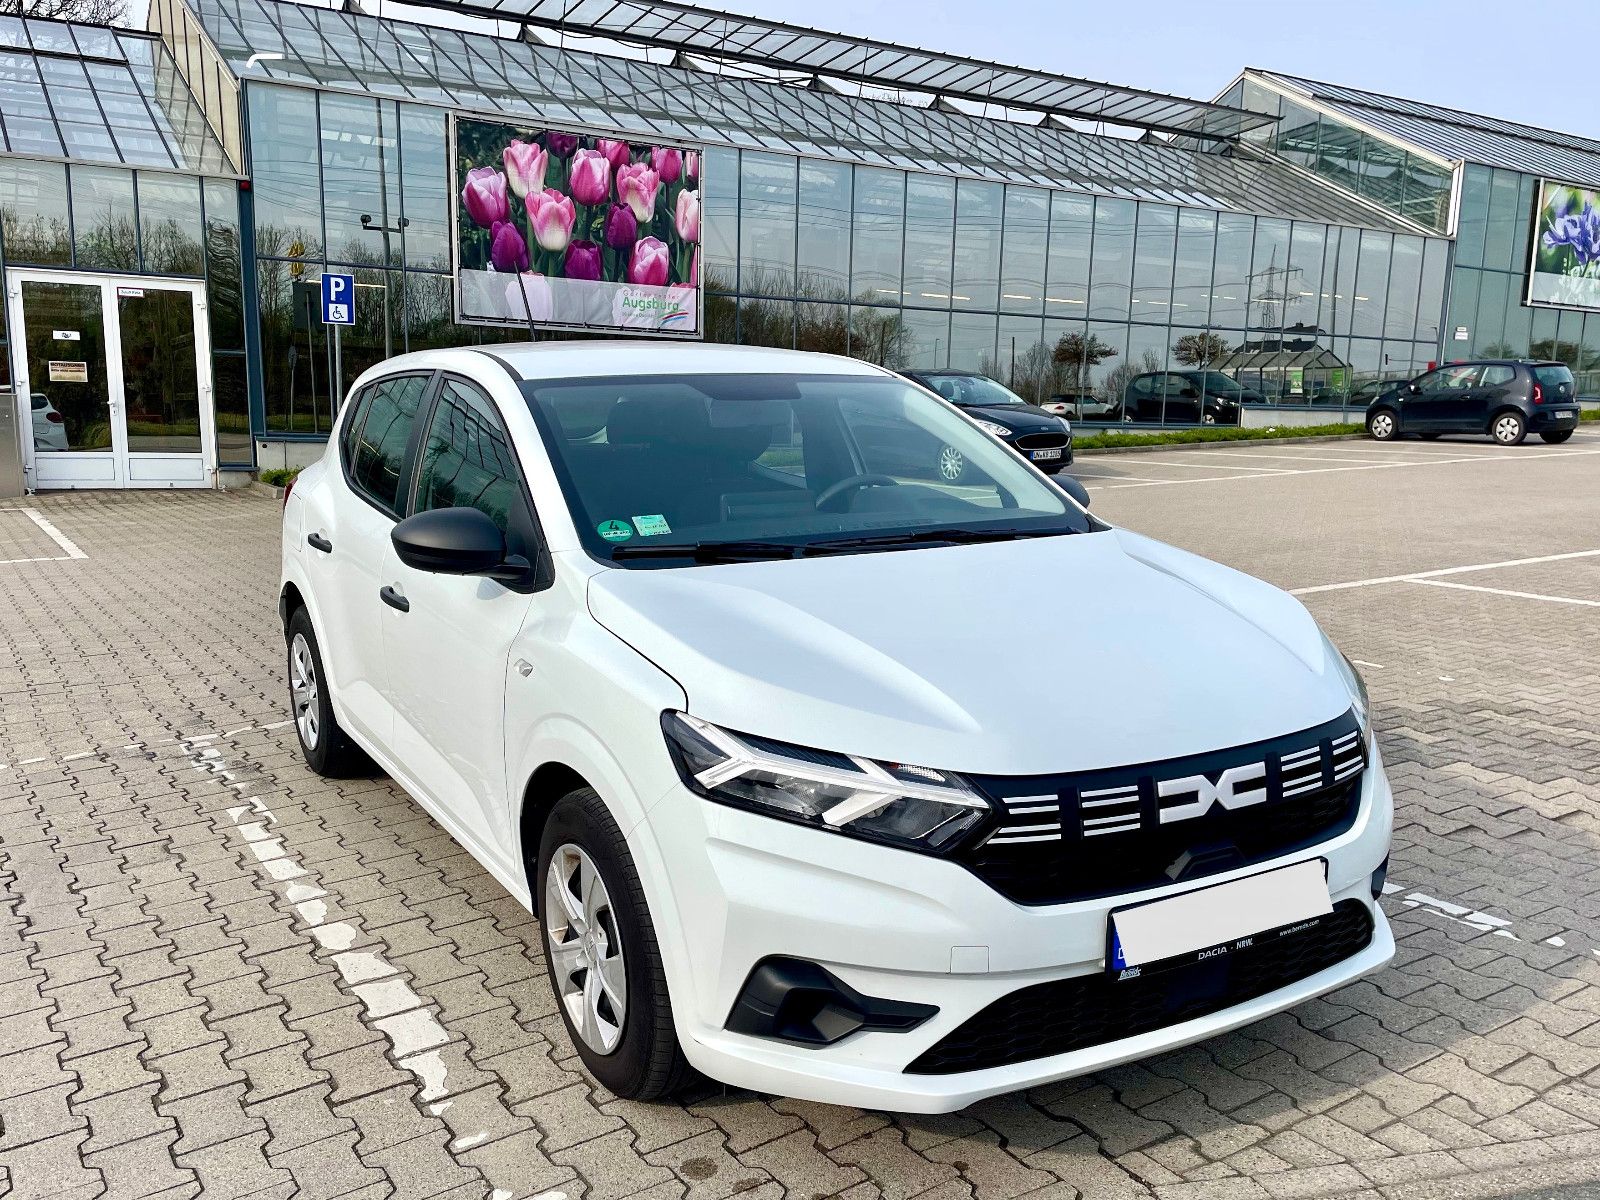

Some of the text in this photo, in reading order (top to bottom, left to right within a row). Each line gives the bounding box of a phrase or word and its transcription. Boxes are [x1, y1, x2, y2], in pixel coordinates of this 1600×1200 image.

[330, 277, 345, 301] P
[622, 297, 679, 311] Augsburg
[609, 521, 619, 530] 4
[1198, 946, 1228, 960] DACIA
